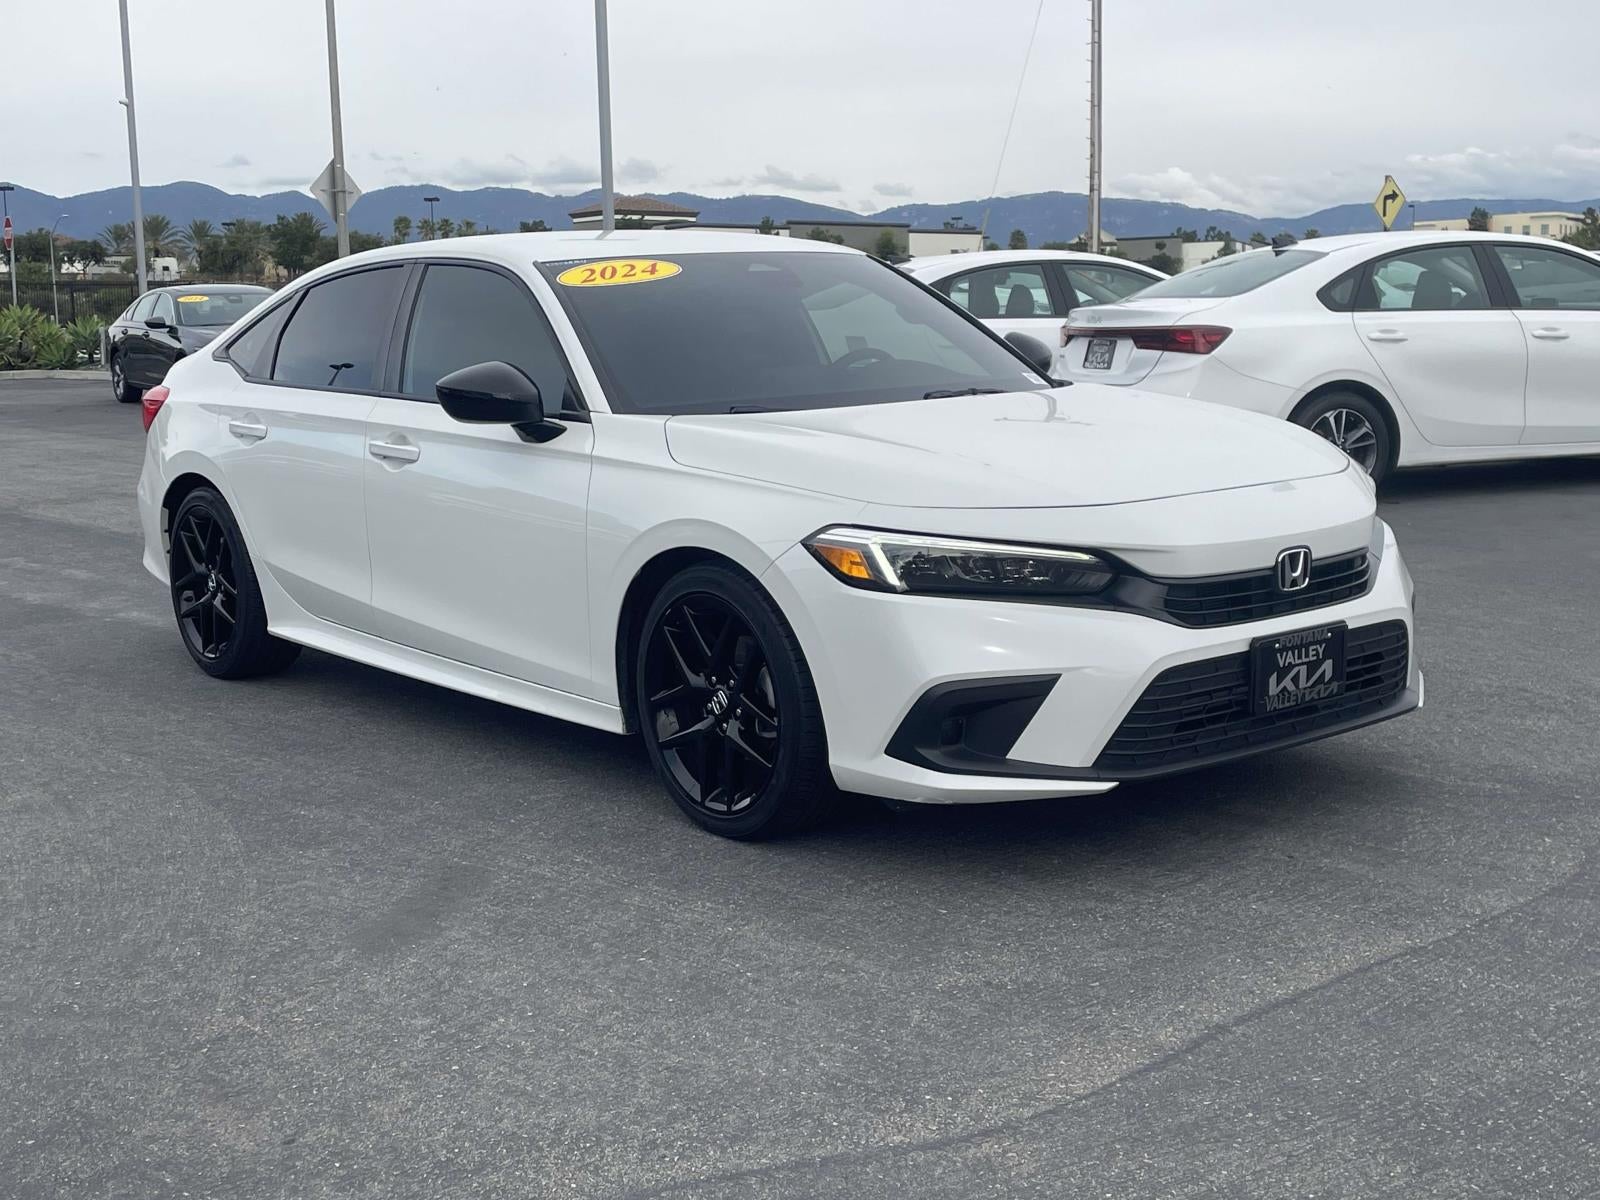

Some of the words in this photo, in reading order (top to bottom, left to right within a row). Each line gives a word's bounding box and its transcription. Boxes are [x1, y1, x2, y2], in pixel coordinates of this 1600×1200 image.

[580, 261, 659, 284] 2024
[1277, 643, 1326, 668] VALLEY
[1269, 659, 1333, 696] KIA
[1264, 689, 1304, 712] VALLEY
